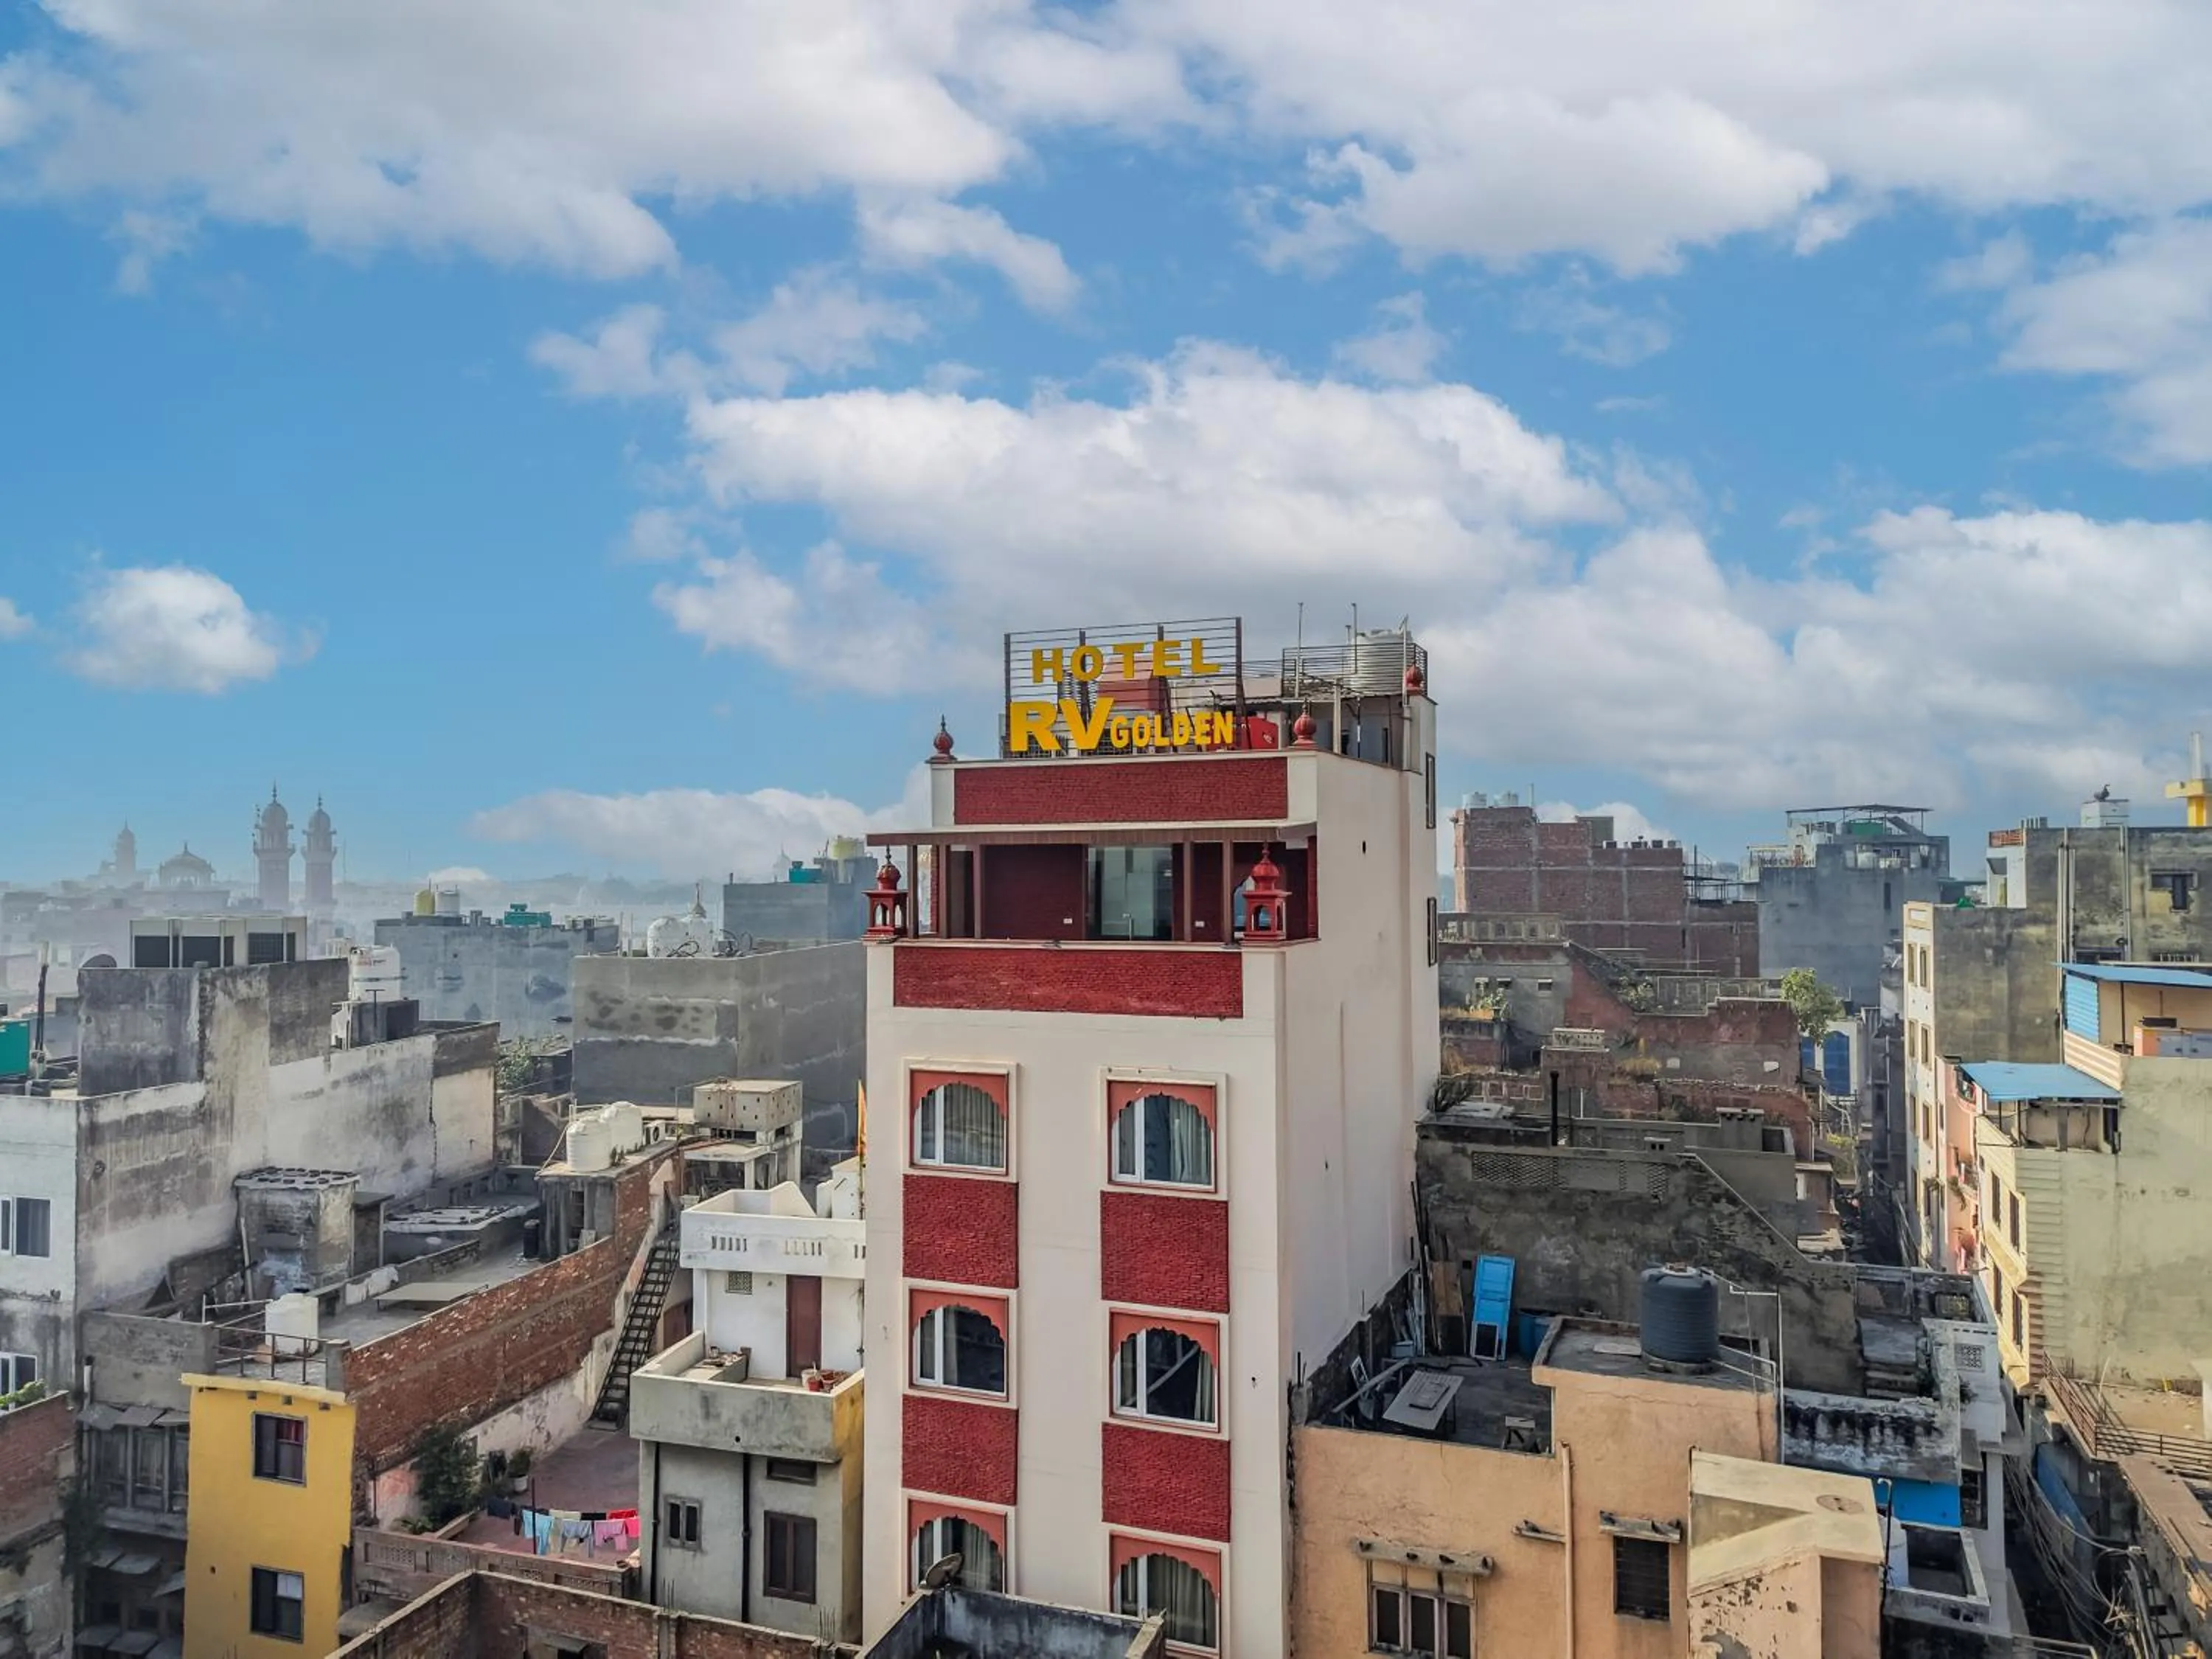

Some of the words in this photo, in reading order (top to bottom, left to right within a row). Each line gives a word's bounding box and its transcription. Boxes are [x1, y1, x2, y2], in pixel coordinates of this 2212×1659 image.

[1032, 637, 1221, 683] HOTEL
[1009, 697, 1115, 752] RV
[1110, 712, 1234, 748] GOLDEN
